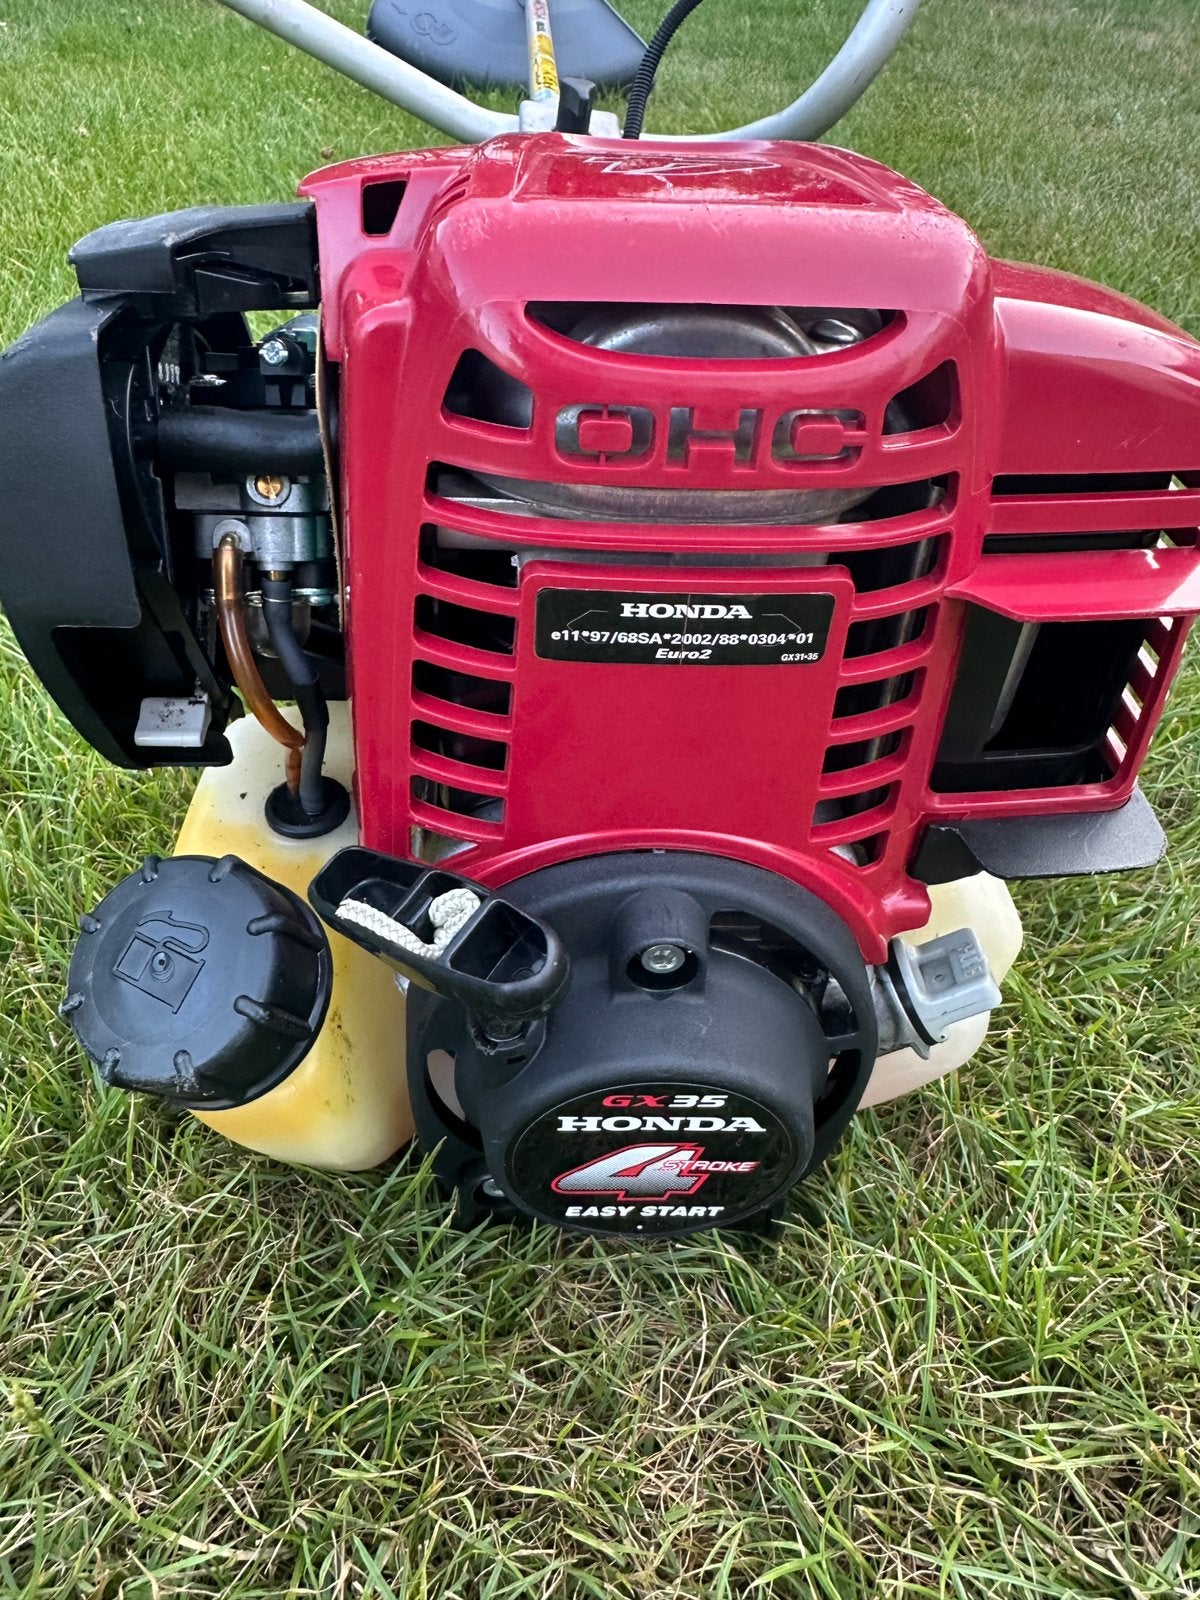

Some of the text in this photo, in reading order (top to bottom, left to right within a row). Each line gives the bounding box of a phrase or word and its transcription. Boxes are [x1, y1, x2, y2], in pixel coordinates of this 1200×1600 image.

[554, 403, 867, 473] OHC
[620, 602, 754, 620] HONDA
[655, 647, 713, 661] Euro2
[556, 1116, 767, 1133] HONDA
[550, 1142, 756, 1202] 4 STROKE
[564, 1205, 725, 1217] EASY START
